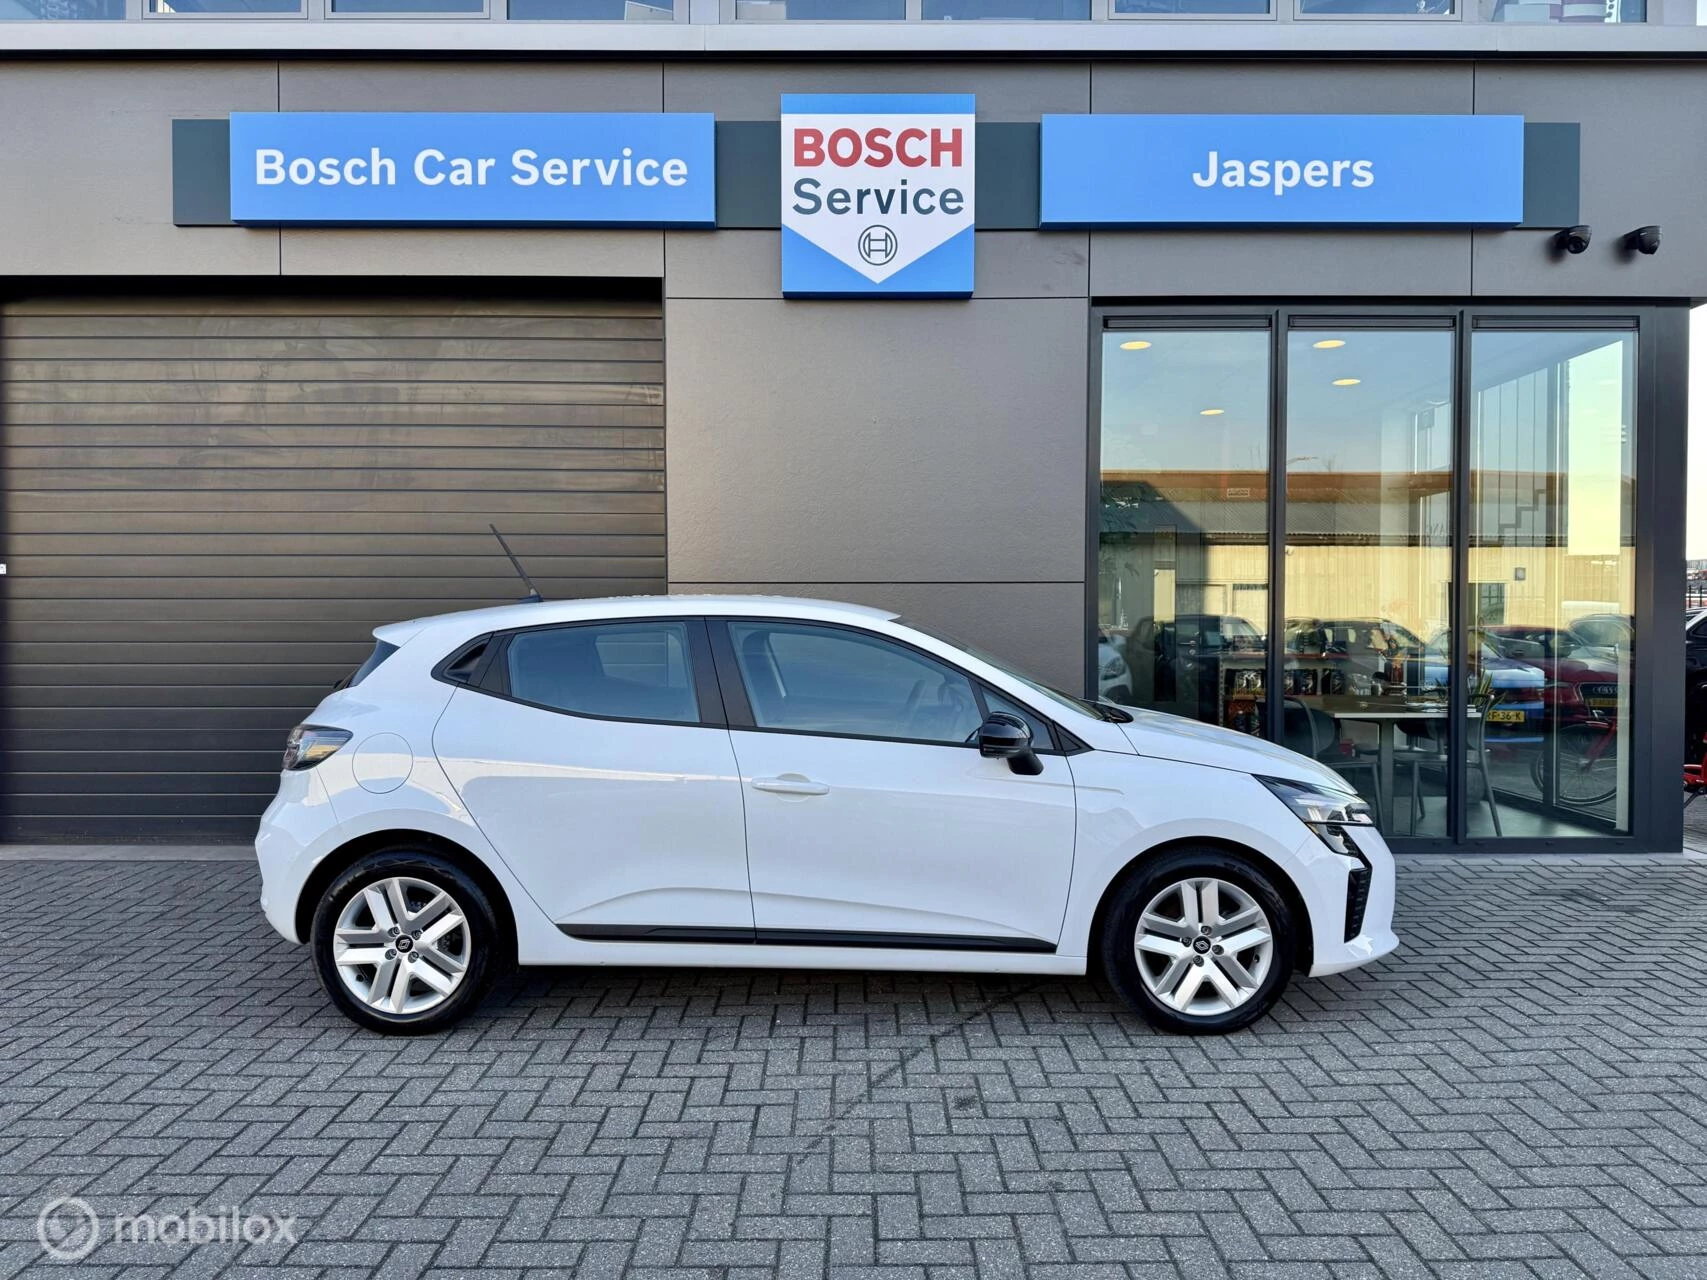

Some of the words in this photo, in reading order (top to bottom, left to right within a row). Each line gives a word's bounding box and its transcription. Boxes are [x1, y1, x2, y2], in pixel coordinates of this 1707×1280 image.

[256, 147, 396, 186] Bosch
[414, 148, 496, 186] Car
[511, 147, 688, 186] Service
[794, 128, 962, 168] BOSCH
[1192, 151, 1374, 196] Jaspers
[792, 177, 964, 215] Service
